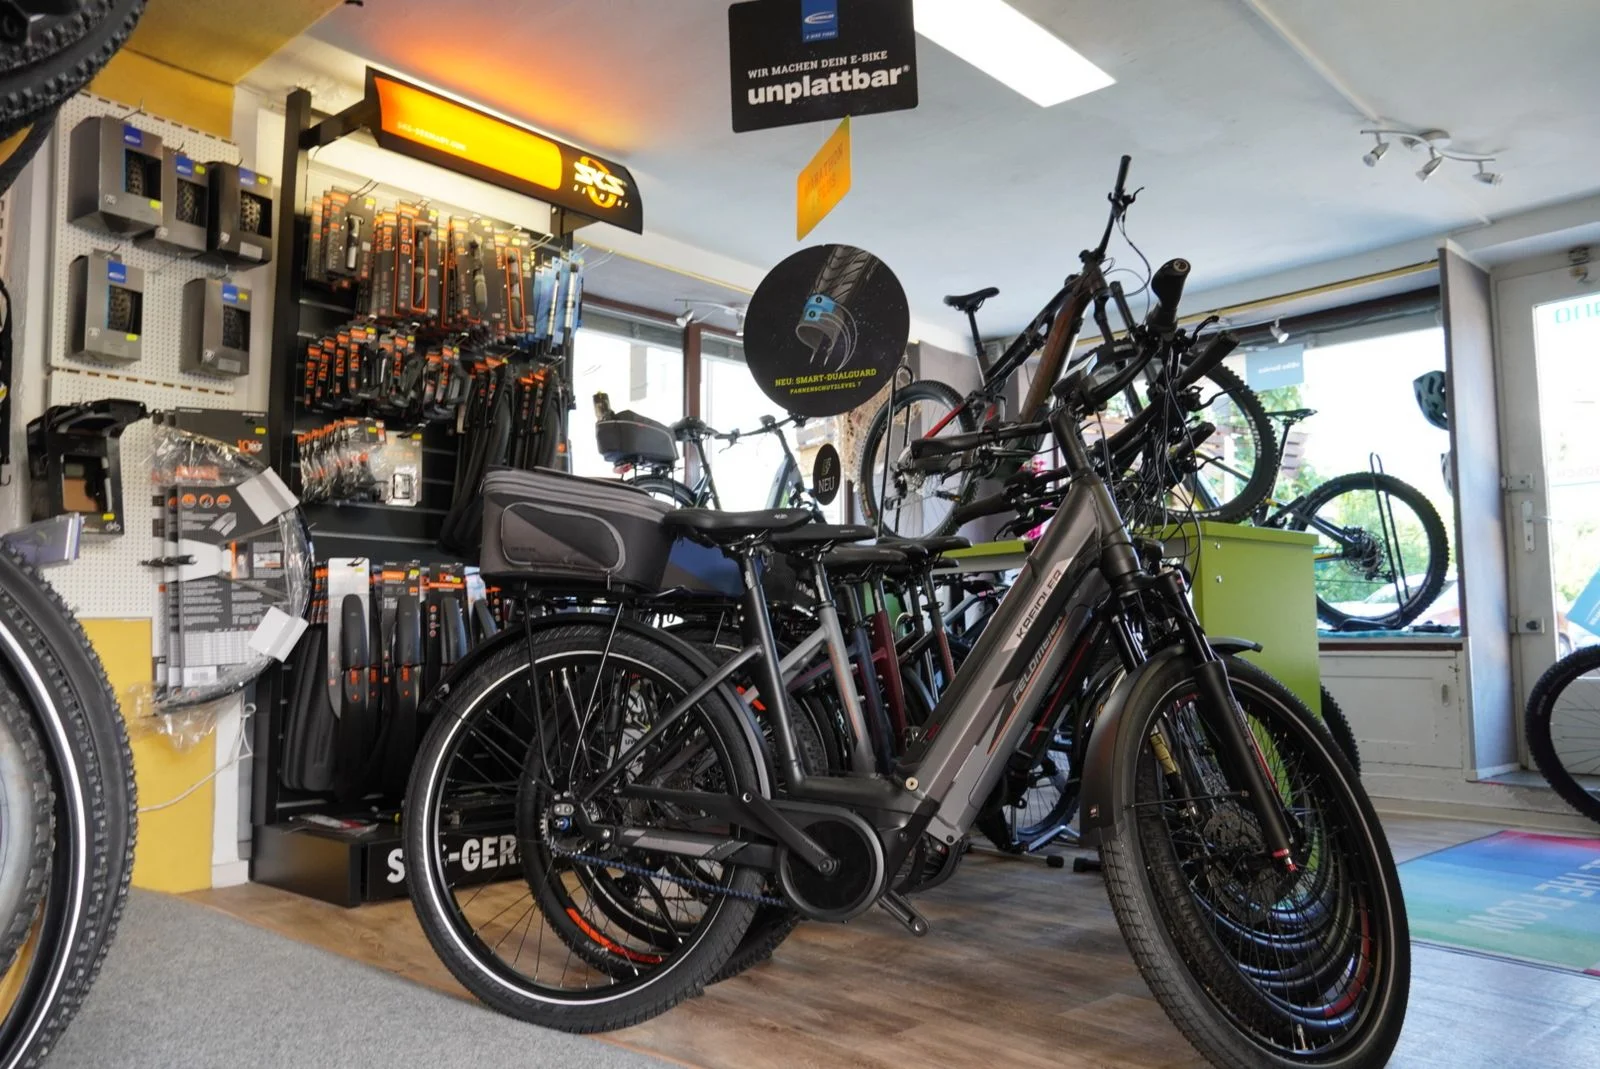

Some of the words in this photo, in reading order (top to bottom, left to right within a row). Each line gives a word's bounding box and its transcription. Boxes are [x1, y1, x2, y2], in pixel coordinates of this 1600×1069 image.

[748, 69, 768, 79] WIR
[772, 61, 818, 76] MACHEN
[821, 56, 847, 68] DEIN
[850, 50, 888, 65] E-BIKE
[574, 160, 627, 196] SKS
[796, 368, 877, 384] SMART-DUALGUARD
[818, 477, 835, 493] NEU
